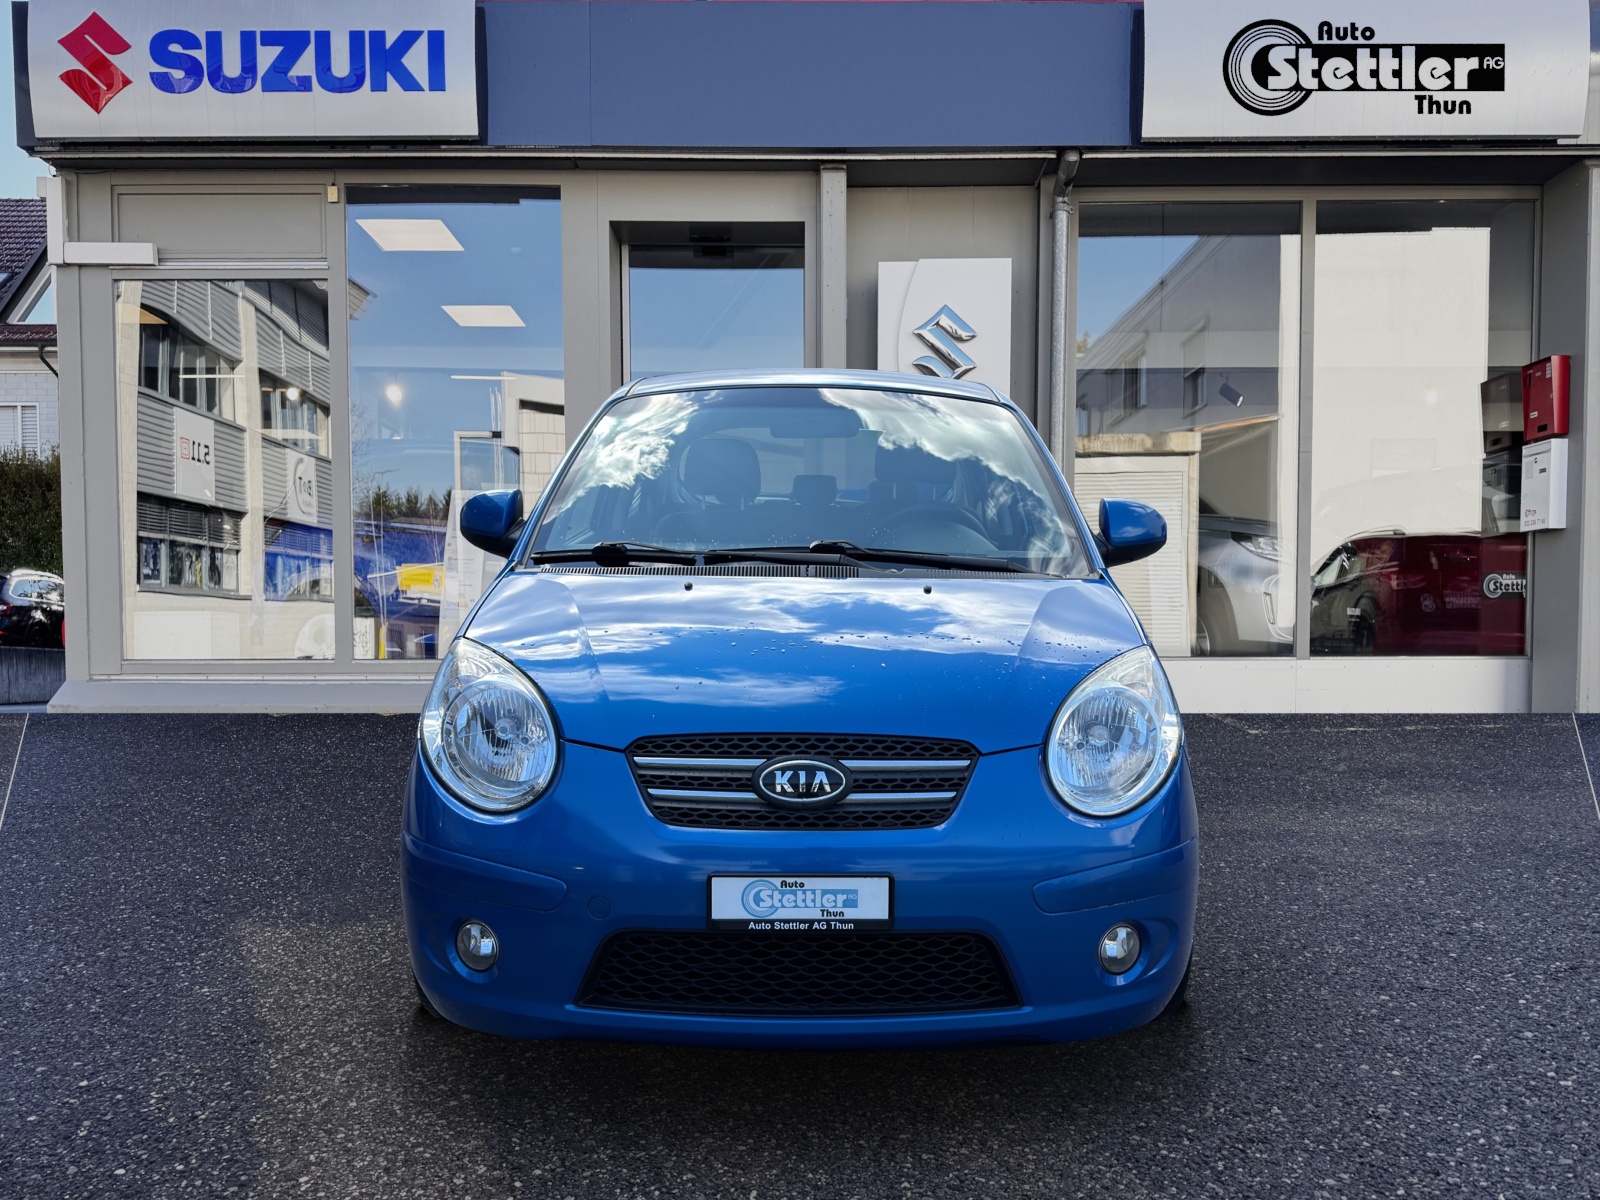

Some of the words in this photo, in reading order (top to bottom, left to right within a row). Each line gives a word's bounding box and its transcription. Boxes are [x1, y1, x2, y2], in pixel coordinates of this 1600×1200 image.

[1317, 20, 1376, 42] Auto
[149, 29, 446, 94] SUZUKI
[1267, 45, 1480, 91] Stettler
[1483, 56, 1505, 70] AG
[1414, 94, 1472, 115] Thun
[773, 770, 832, 793] KIA
[780, 880, 805, 889] Auto
[759, 889, 848, 908] Stettler
[847, 893, 858, 901] AG
[819, 909, 845, 918] Thun
[748, 921, 772, 930] Auto
[774, 921, 810, 930] Stettler
[812, 921, 827, 930] AG
[830, 921, 854, 930] Thun
